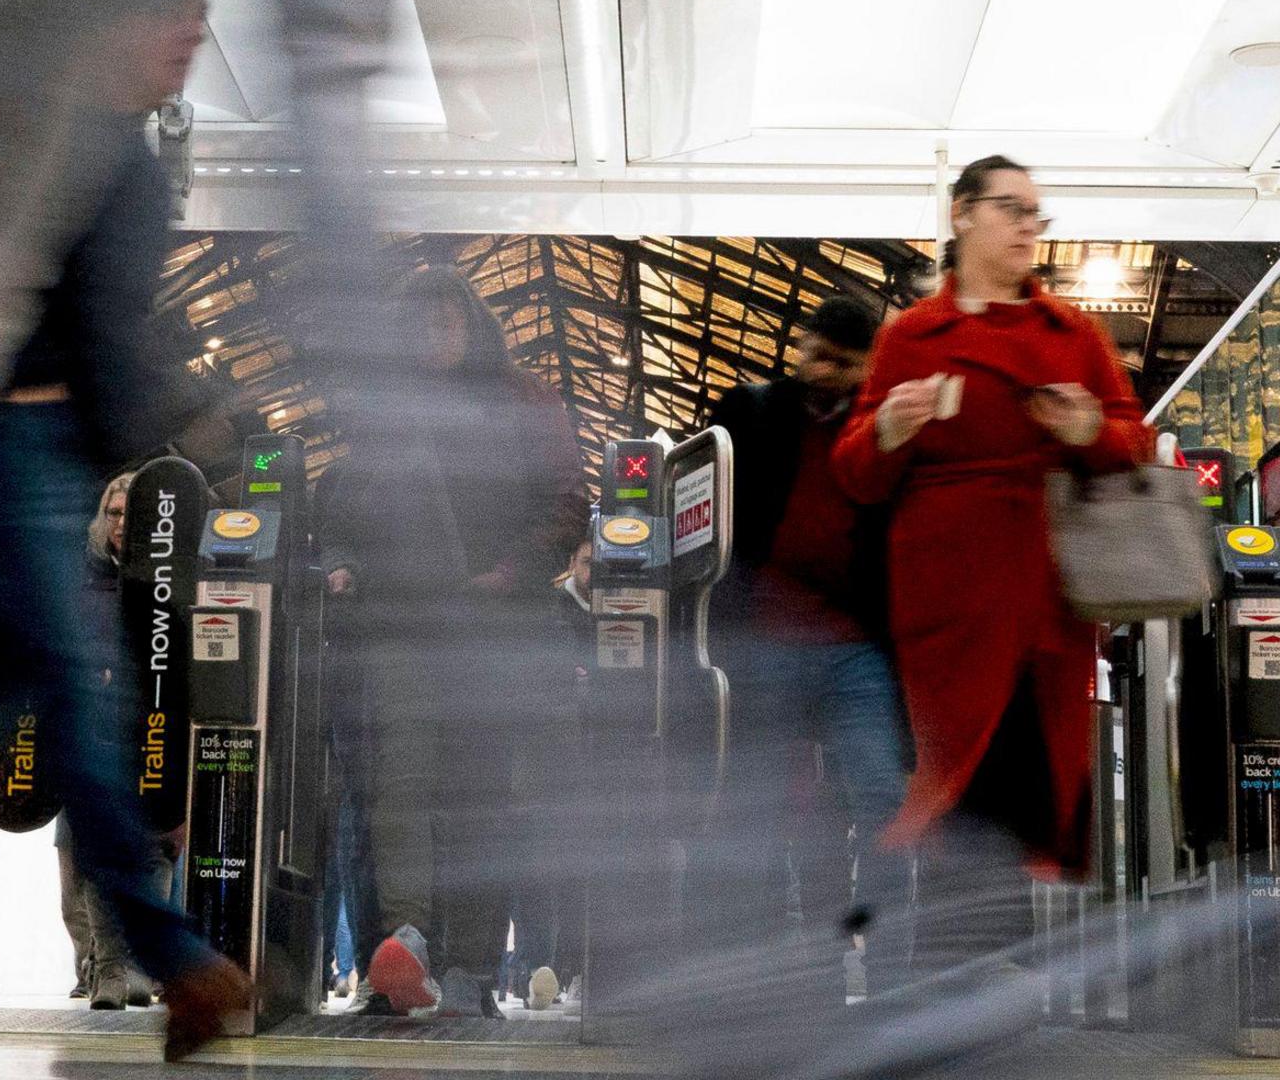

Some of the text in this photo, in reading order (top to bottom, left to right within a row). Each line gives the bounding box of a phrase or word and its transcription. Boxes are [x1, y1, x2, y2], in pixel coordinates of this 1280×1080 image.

[140, 489, 176, 796] Trains now on Uber
[222, 737, 254, 749] credit
[7, 714, 37, 797] Trains
[201, 749, 226, 760] back
[1242, 754, 1266, 766] 10%
[1246, 766, 1271, 777] back
[1240, 780, 1270, 791] every
[223, 857, 247, 867] now
[199, 868, 214, 879] on
[1252, 887, 1266, 897] on
